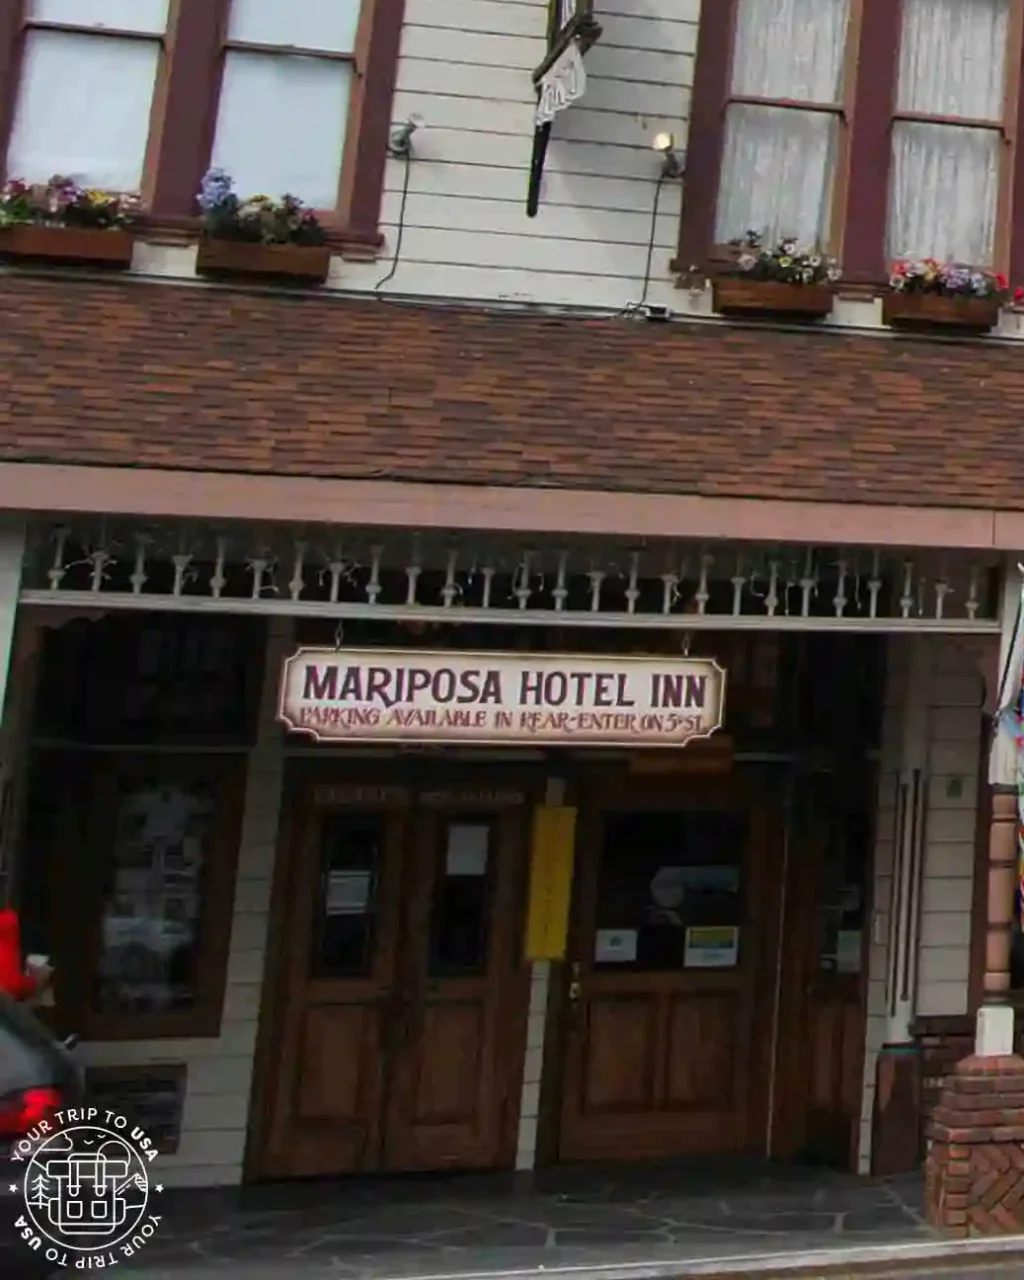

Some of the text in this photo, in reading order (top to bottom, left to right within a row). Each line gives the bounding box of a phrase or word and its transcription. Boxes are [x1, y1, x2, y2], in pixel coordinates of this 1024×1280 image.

[303, 664, 709, 709] MARIPOSA HOTEL INN
[301, 706, 380, 729] PARKING
[387, 708, 488, 728] AVAILABLE
[495, 710, 513, 729] IN
[641, 714, 664, 732] ON
